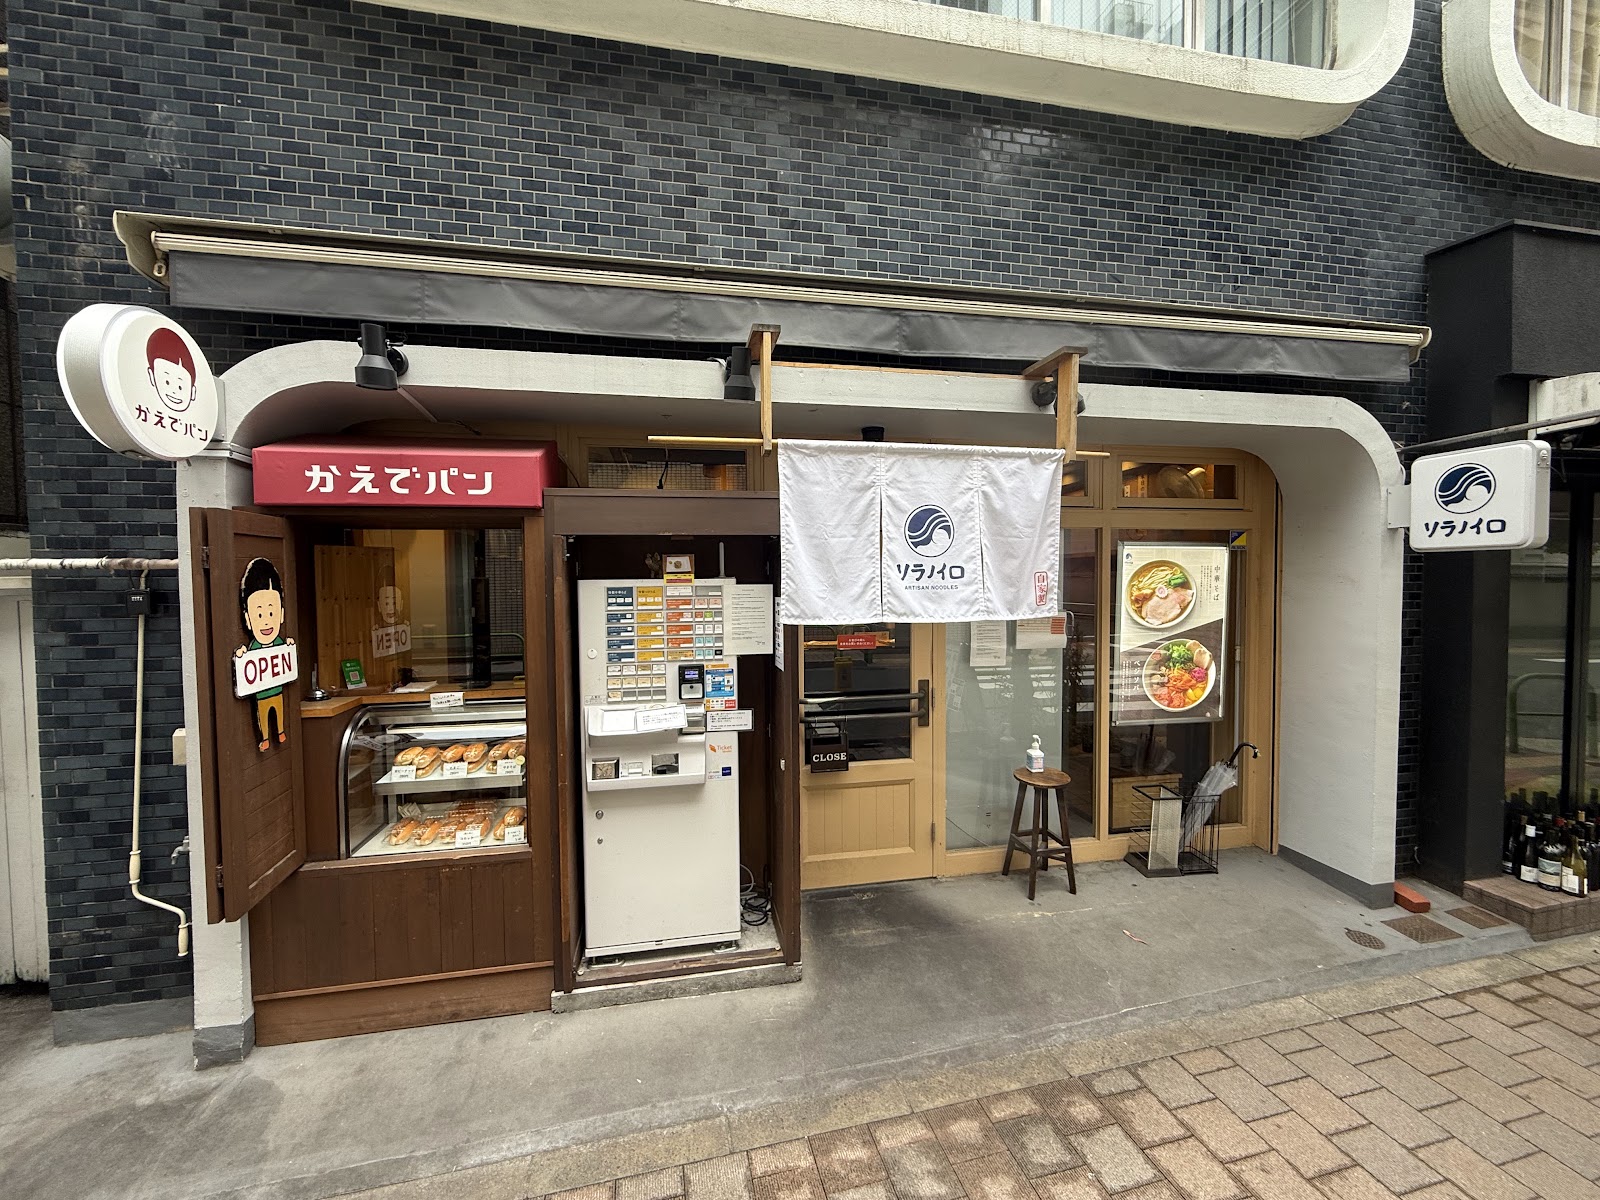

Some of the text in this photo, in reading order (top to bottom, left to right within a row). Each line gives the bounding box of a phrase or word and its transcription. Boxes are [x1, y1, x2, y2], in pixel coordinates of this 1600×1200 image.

[135, 404, 208, 441] かえでパン
[304, 464, 493, 495] かえでパン
[1424, 517, 1506, 538] ソラノイロ
[896, 562, 965, 582] ソラノイロ
[1213, 565, 1221, 601] 中華そば
[1037, 573, 1047, 604] 自家製
[243, 651, 292, 685] OPEN
[812, 752, 847, 762] CLOSE
